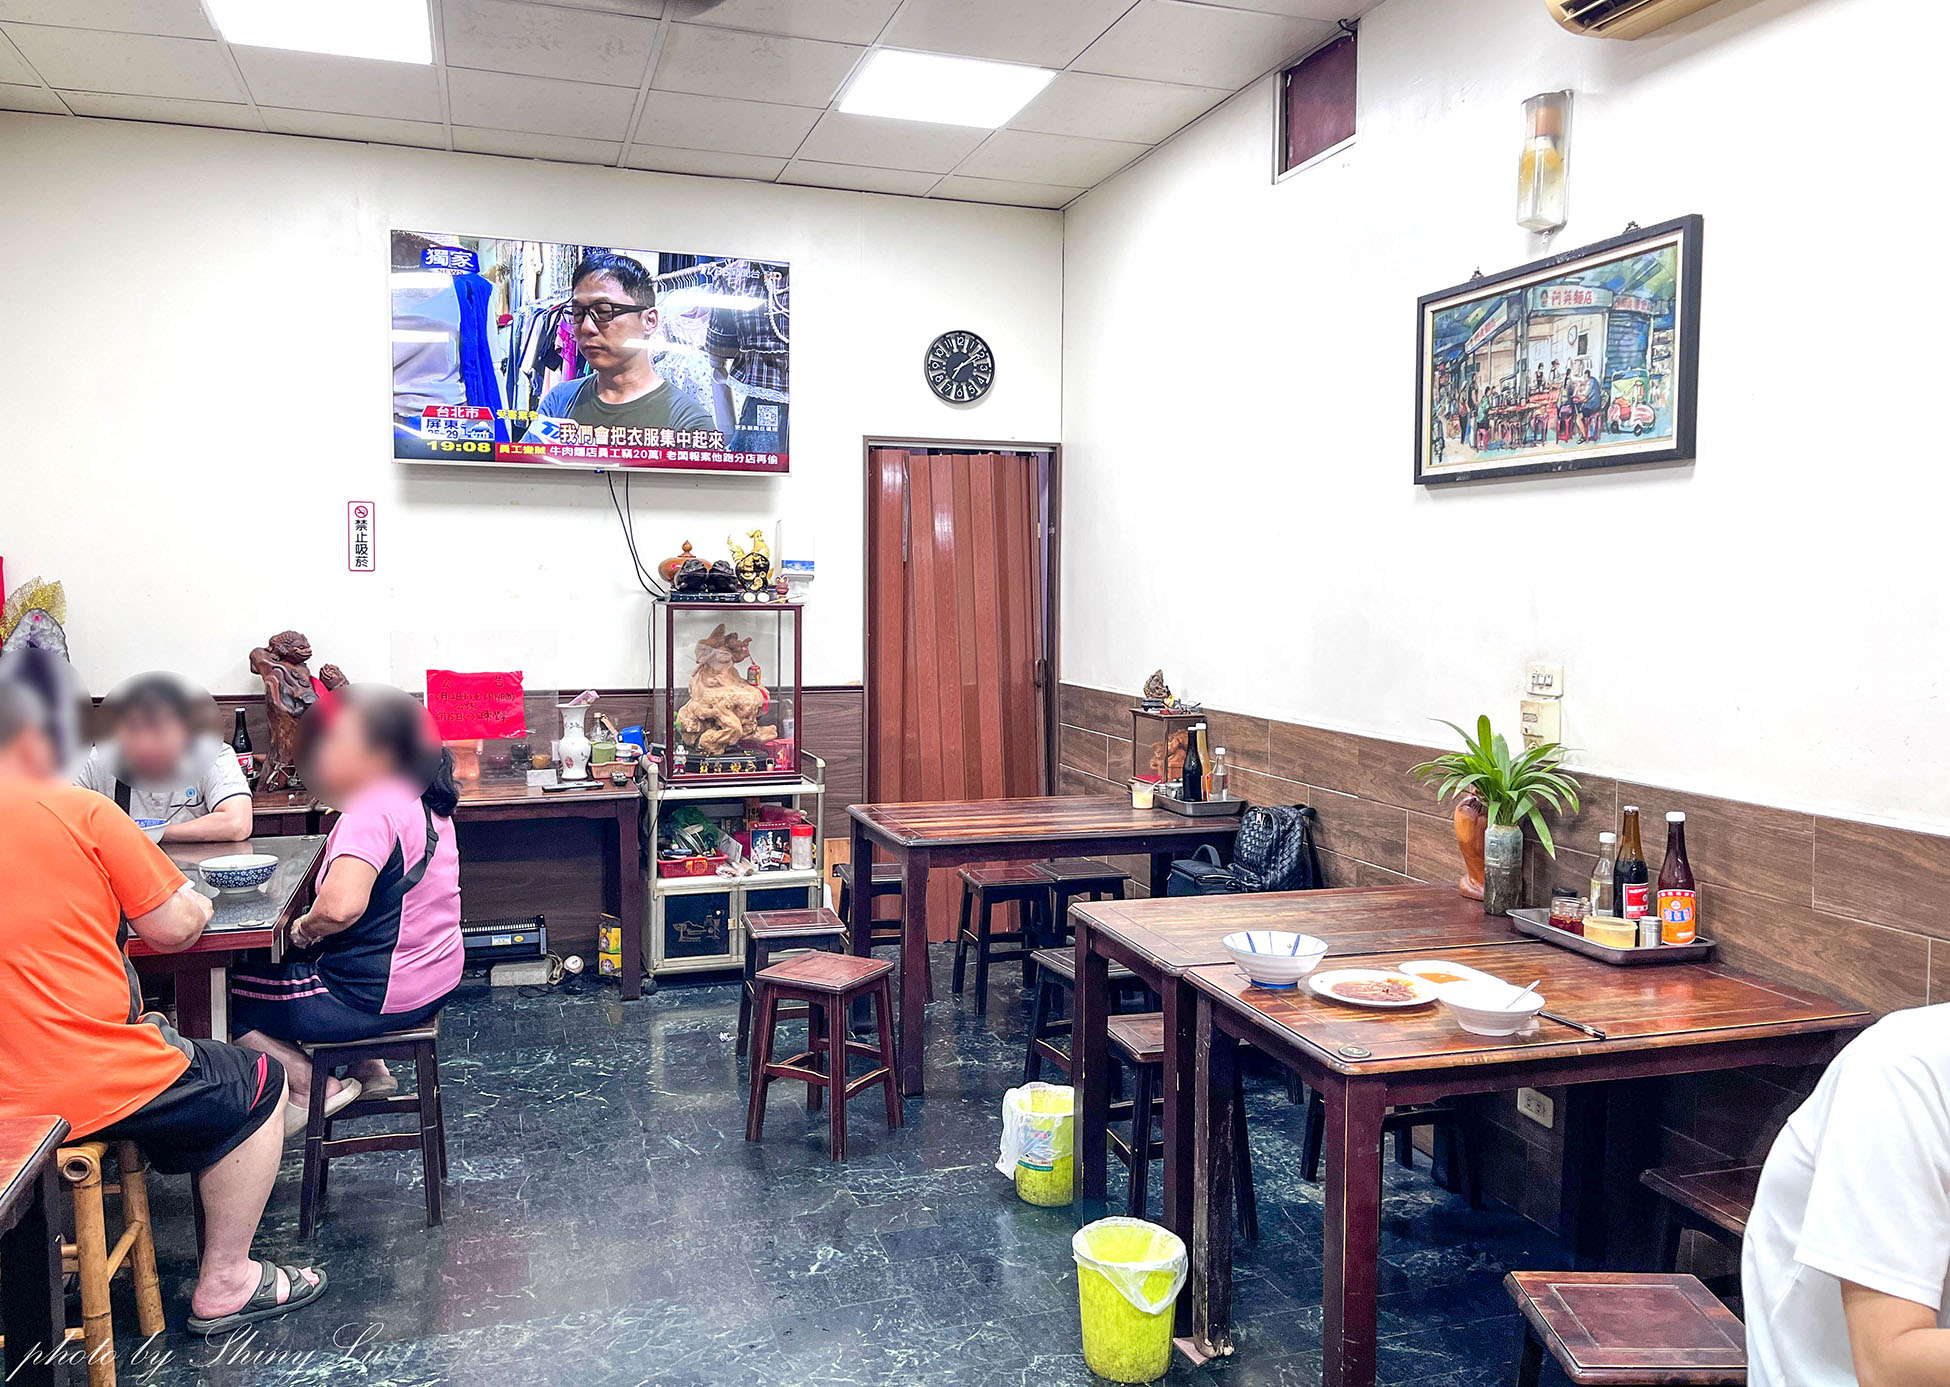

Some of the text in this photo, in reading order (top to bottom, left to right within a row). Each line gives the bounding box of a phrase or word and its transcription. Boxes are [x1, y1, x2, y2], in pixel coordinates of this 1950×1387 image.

[425, 248, 474, 268] 獨家
[436, 406, 480, 419] 台北市
[426, 418, 459, 430] 屏東
[560, 423, 724, 449] 我們會把衣服集中起來
[426, 440, 492, 453] 19:08
[354, 519, 369, 568] 禁止吸菸
